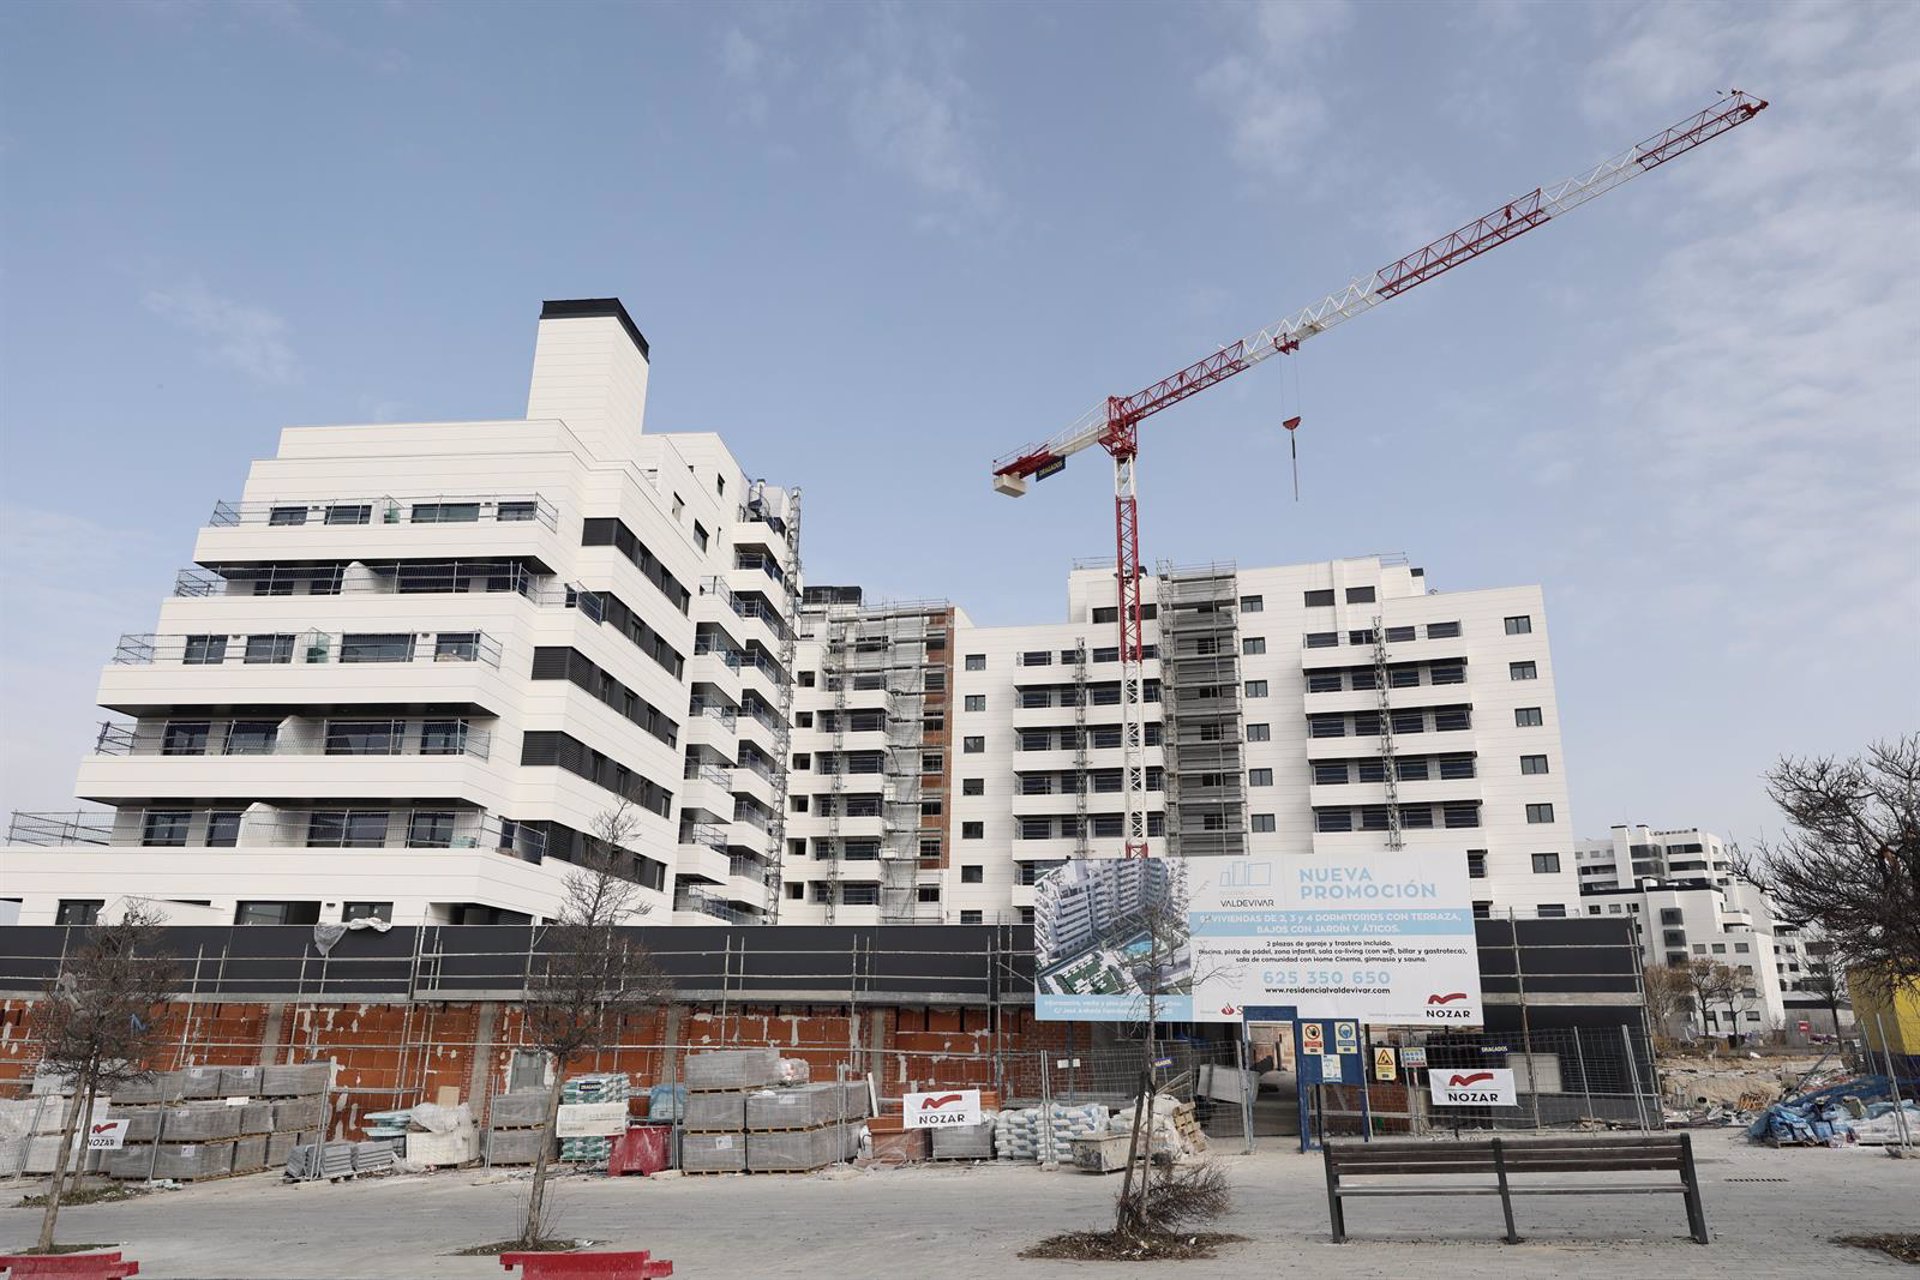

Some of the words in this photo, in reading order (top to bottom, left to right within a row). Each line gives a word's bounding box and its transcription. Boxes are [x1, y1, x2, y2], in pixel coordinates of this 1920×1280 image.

[1300, 868, 1372, 881] NUEVA
[1301, 880, 1436, 899] PROMOCIÓN
[1220, 899, 1274, 907] VALDEVIVAR
[1315, 913, 1384, 921] DORMITORIOS
[1411, 912, 1461, 921] TERRAZA,
[1257, 925, 1288, 933] BAJOS
[1290, 925, 1311, 933] CON
[1263, 972, 1298, 984] 625
[1307, 971, 1343, 984] 350
[1353, 971, 1390, 984] 650
[1426, 1010, 1471, 1018] NOZAR
[1448, 1093, 1499, 1102] NOZAR
[918, 1113, 966, 1124] NOZAR
